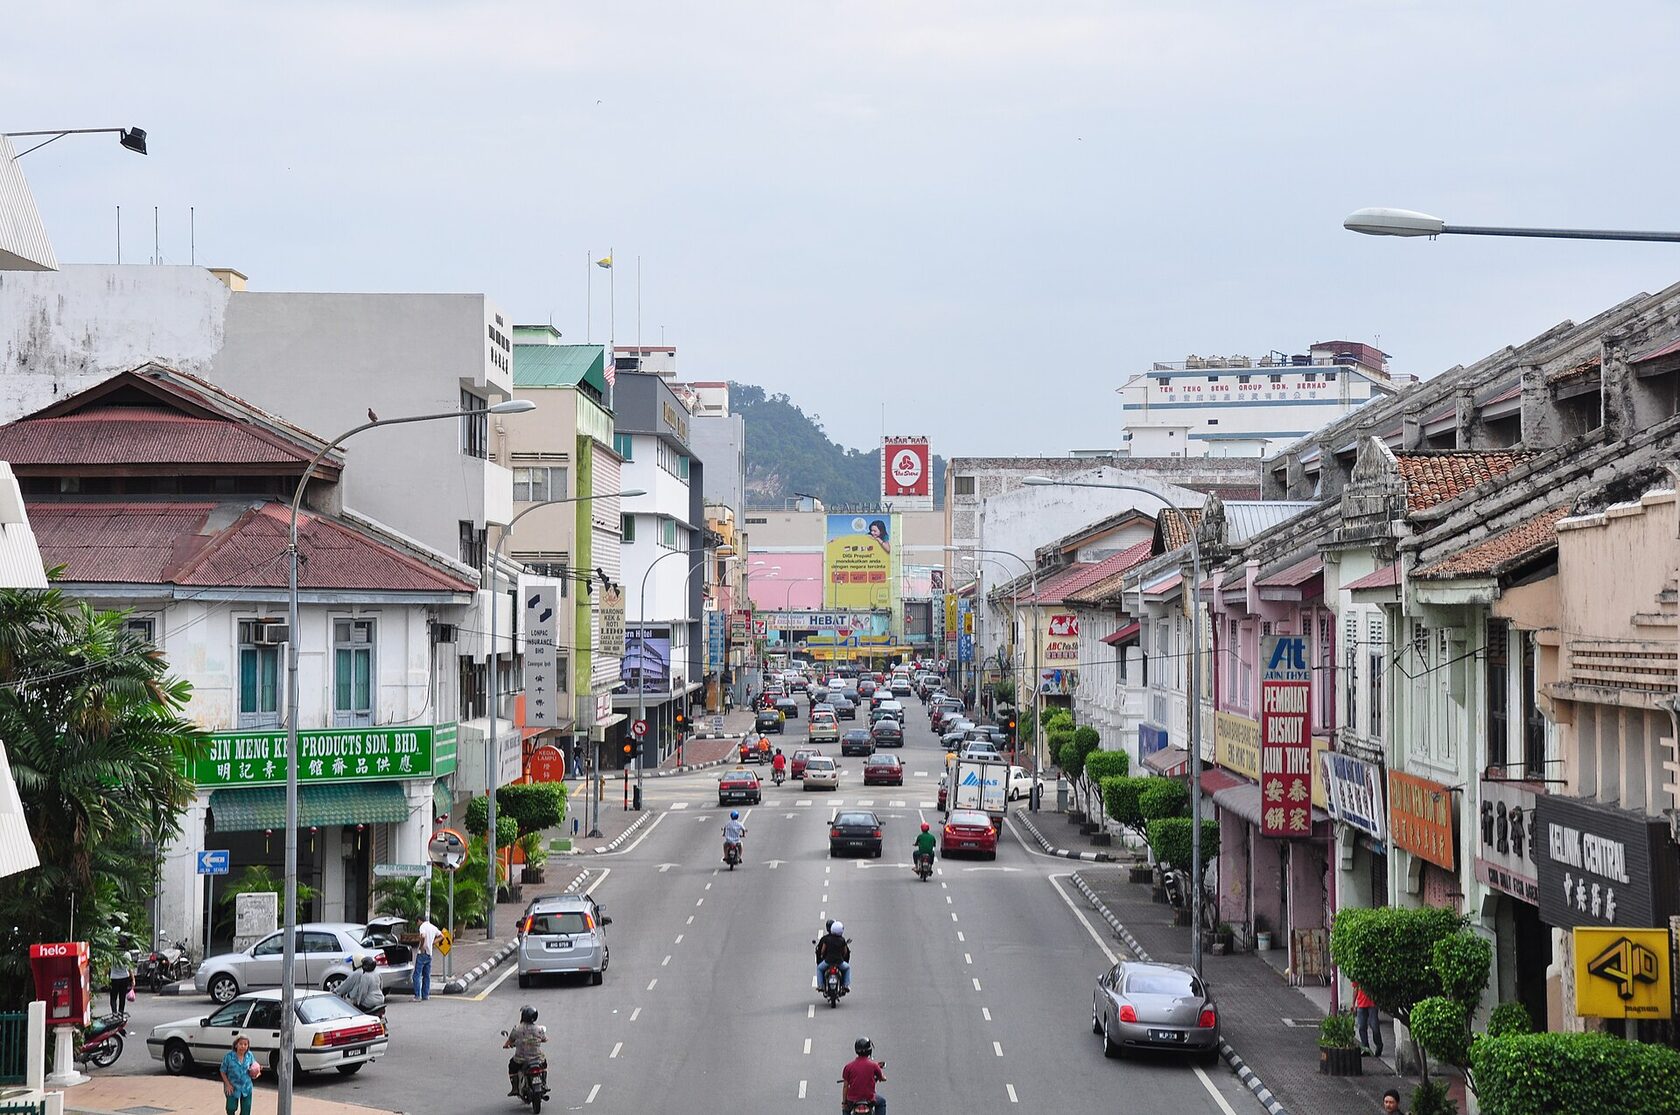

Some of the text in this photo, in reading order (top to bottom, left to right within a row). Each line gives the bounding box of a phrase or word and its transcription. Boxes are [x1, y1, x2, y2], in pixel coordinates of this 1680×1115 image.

[1211, 384, 1229, 392] SENG
[1296, 382, 1327, 390] BERHAD
[830, 502, 893, 513] CATHAY
[635, 629, 653, 638] Htel
[1046, 641, 1062, 651] ABC
[1264, 671, 1310, 680] AUN THYE
[1264, 686, 1309, 713] PEMBUAT
[1268, 716, 1305, 744] BISKUT
[210, 740, 231, 761] SIN
[235, 738, 269, 760] MENG
[302, 733, 361, 757] PRODUCTS
[366, 733, 390, 755] SDN.
[395, 732, 420, 754] BHD.
[1263, 746, 1283, 774] AUN
[1285, 747, 1310, 774] THYE
[1583, 832, 1630, 884] CENTRAL
[1624, 1005, 1659, 1015] magnum
